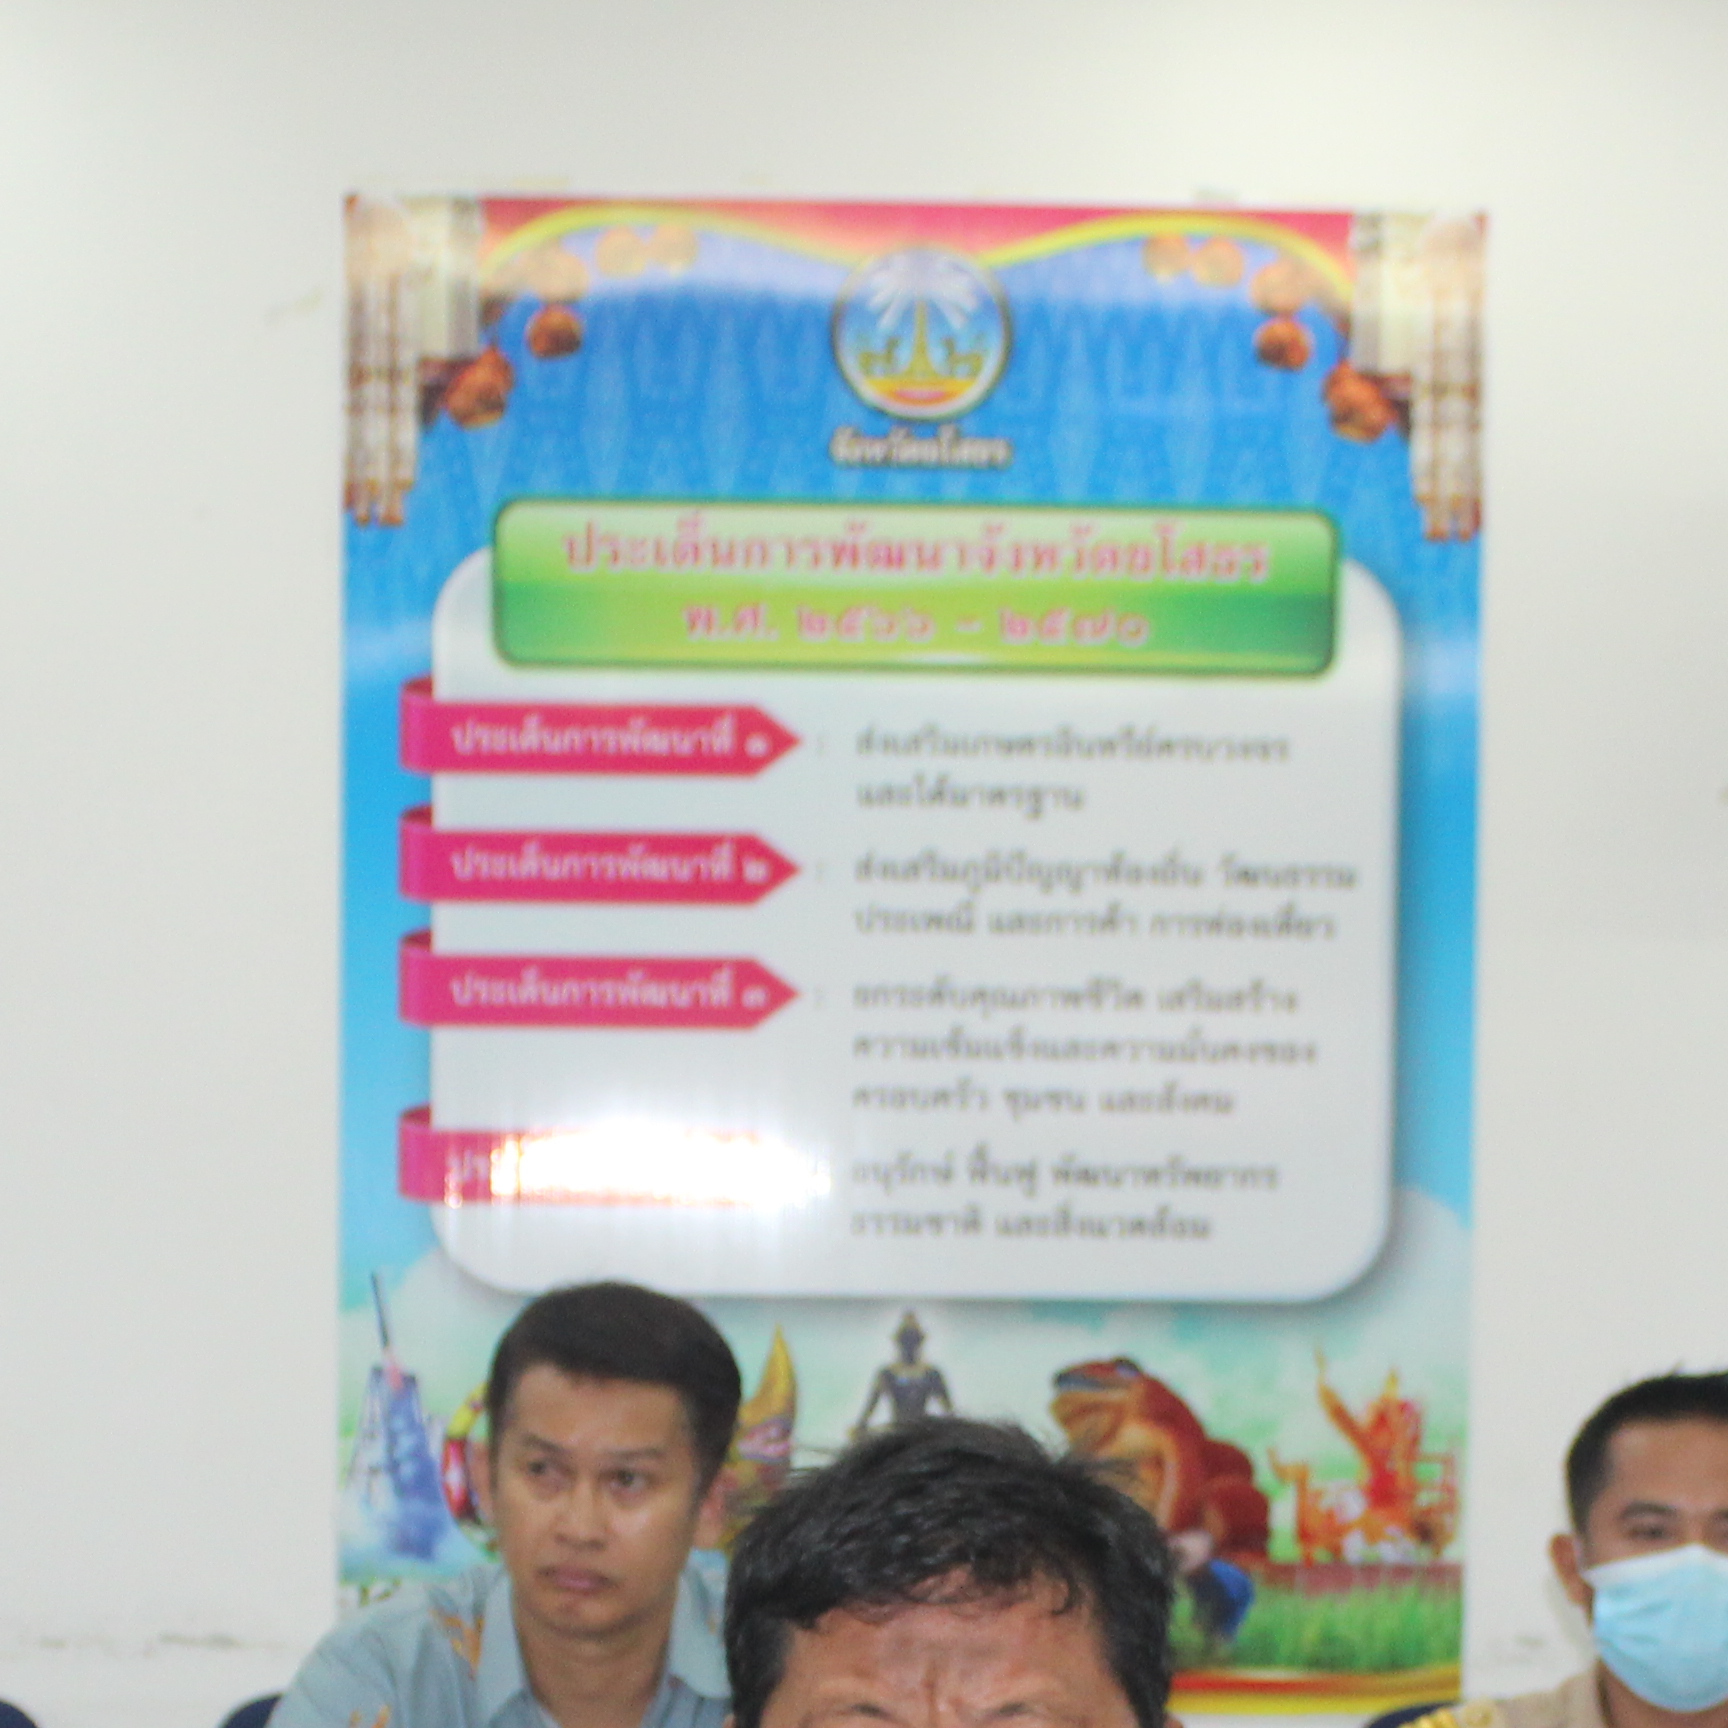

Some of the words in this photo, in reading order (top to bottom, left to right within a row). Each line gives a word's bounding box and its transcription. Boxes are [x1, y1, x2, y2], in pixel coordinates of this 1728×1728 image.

[562, 513, 1270, 582] ประเด็นการพัฒนาจังหวัดยโสธร
[683, 603, 778, 641] พ.ศ.
[451, 712, 736, 756] ประเด็นการพัฒนาที่
[451, 838, 736, 882] ประเด็นการพัฒนาที่
[450, 964, 736, 1009] ประเด็นการพัฒนาที่
